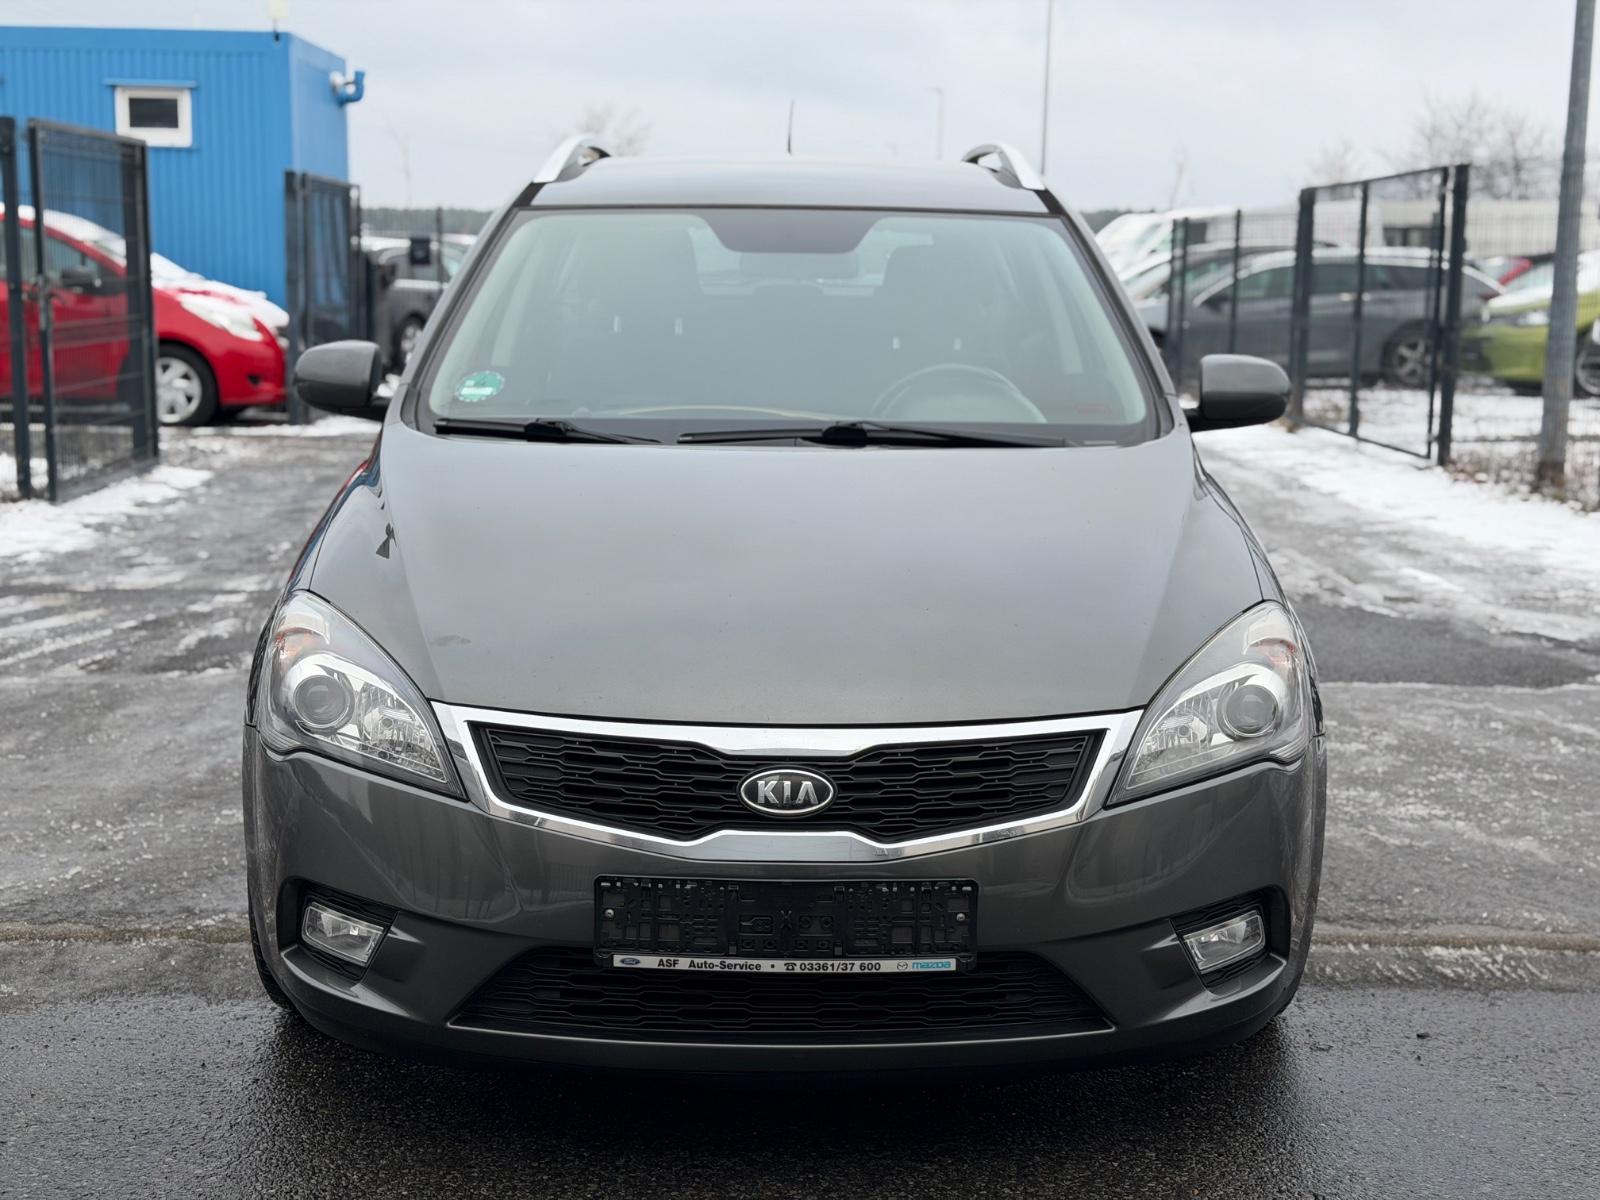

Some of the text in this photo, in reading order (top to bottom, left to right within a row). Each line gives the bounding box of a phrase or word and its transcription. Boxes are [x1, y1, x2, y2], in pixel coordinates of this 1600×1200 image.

[757, 780, 819, 805] KIA
[657, 958, 882, 972] ASF Auto-Service 03361/37 600
